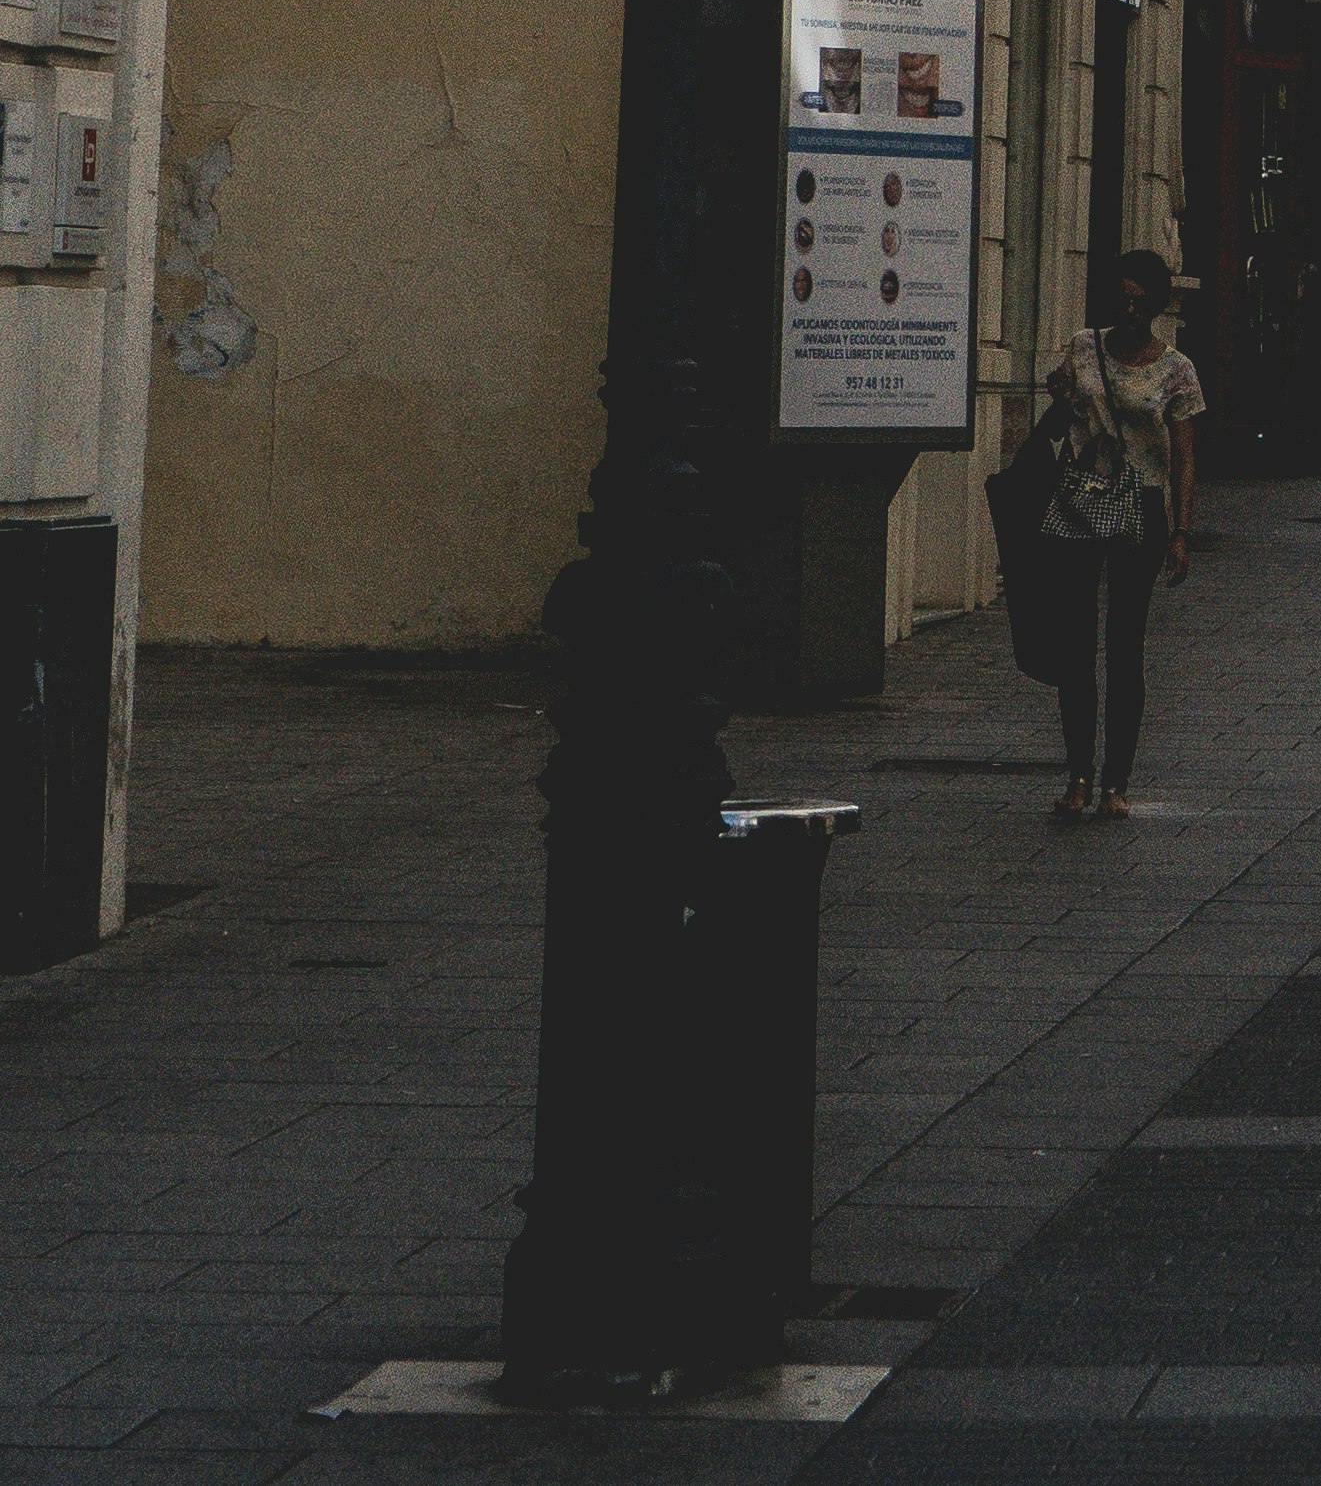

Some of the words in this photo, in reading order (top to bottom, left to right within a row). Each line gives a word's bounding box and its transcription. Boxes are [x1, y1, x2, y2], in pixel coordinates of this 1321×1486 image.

[792, 317, 839, 329] APLICAMOS
[794, 347, 845, 359] MATERIALES
[845, 347, 872, 360] LIBRES
[872, 347, 884, 360] DE
[885, 347, 920, 360] METALES
[846, 375, 863, 389] 957
[863, 376, 878, 389] 48
[879, 376, 891, 389] 12
[892, 377, 905, 390] 31
